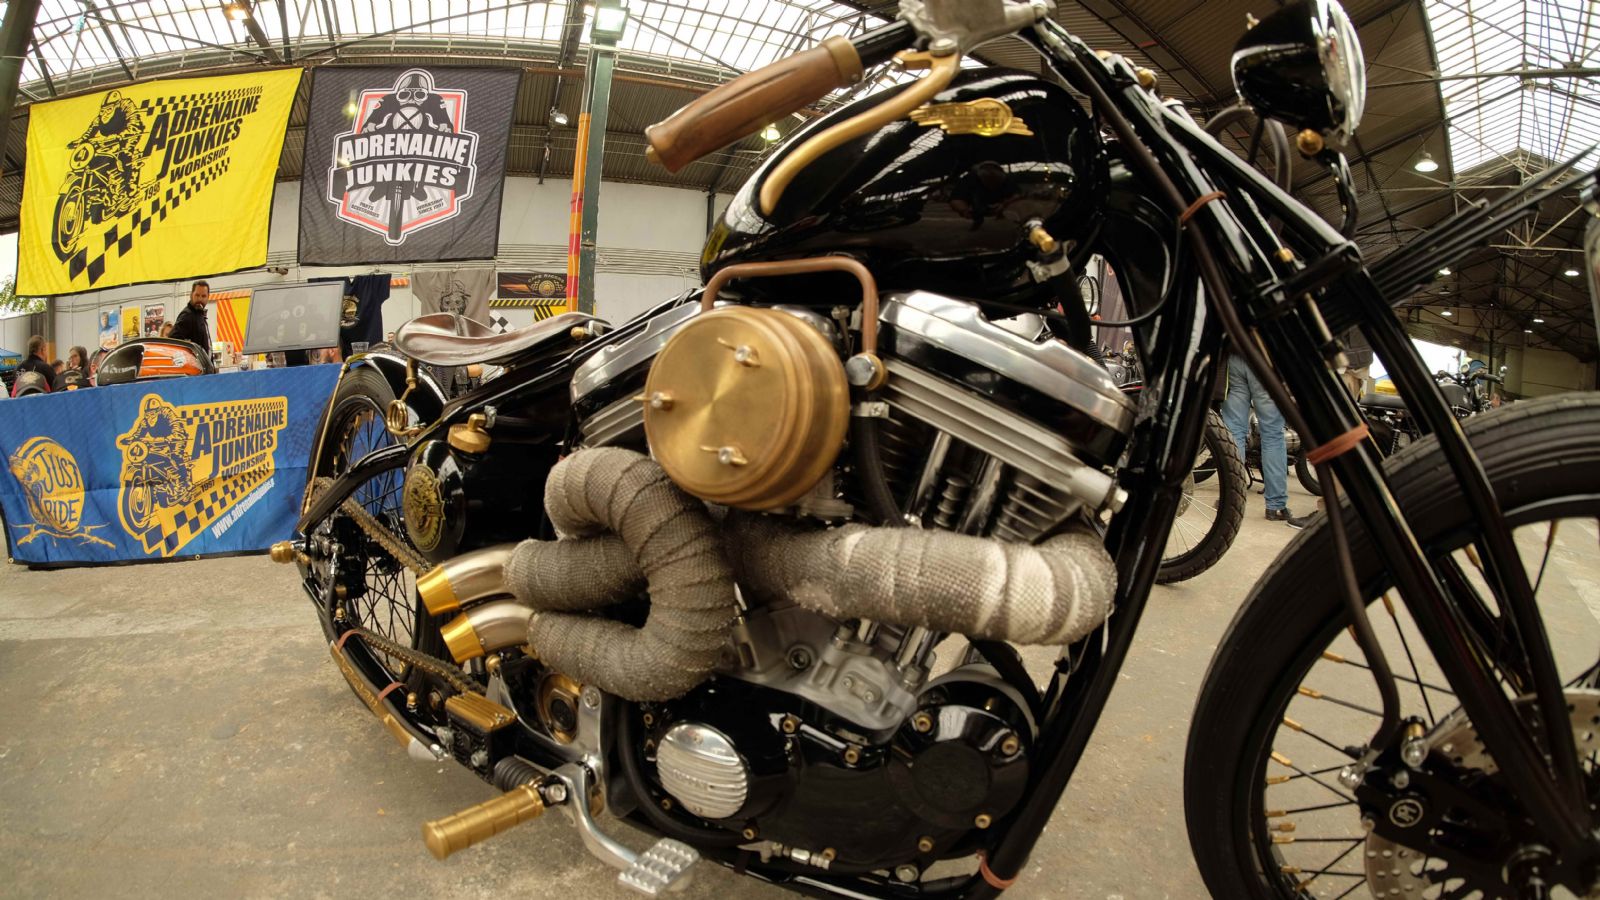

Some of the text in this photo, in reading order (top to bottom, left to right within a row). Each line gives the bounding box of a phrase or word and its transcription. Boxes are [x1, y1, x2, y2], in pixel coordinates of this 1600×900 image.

[143, 95, 261, 157] ADRENALINE
[156, 118, 243, 181] JUNKIES
[170, 146, 229, 184] WORKSHOP
[341, 133, 469, 164] ADRENALINE
[345, 163, 458, 191] JUNKIES
[191, 409, 284, 461] ADRENALINE
[208, 429, 274, 479] JUNKIES
[33, 448, 81, 494] JUST
[221, 452, 267, 482] WORKSHOP
[43, 498, 80, 525] RIDE
